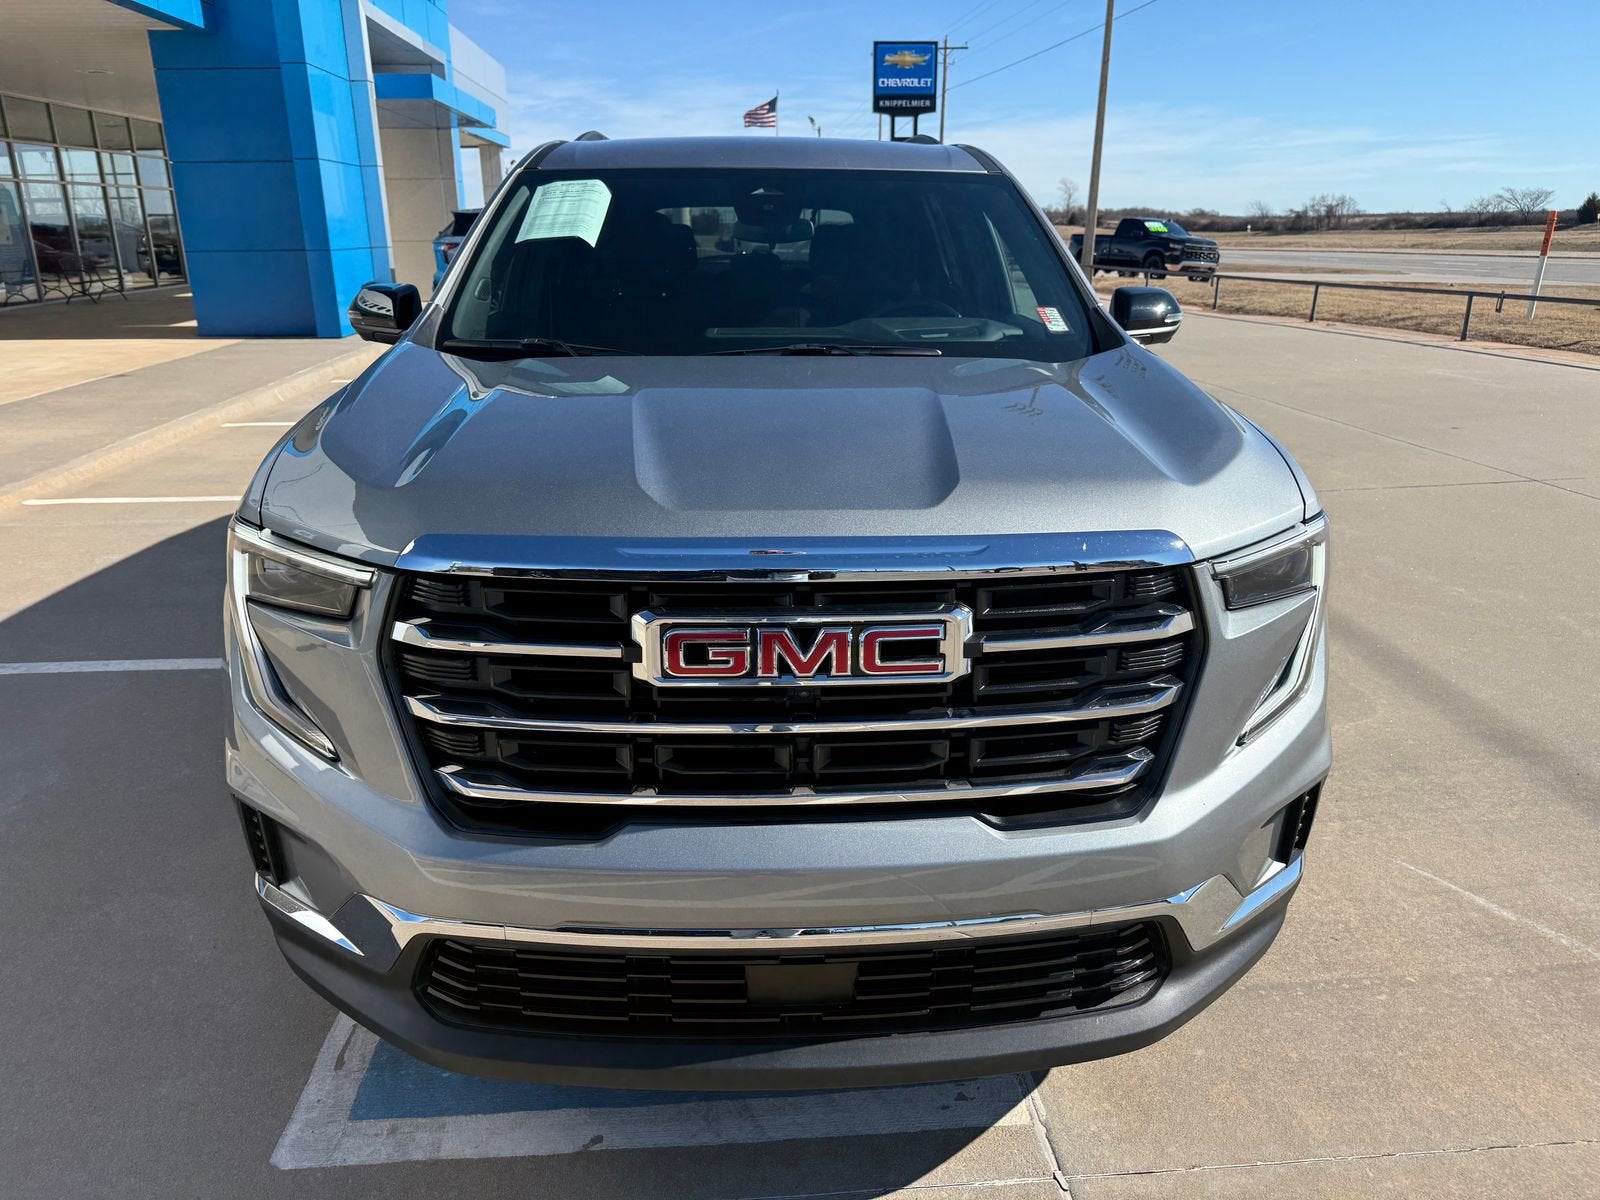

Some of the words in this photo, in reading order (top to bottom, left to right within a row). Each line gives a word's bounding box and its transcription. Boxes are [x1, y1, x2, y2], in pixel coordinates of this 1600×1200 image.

[878, 78, 932, 87] CHEVROLET
[879, 99, 931, 107] KNIPPELMIER
[663, 624, 945, 677] GMC
